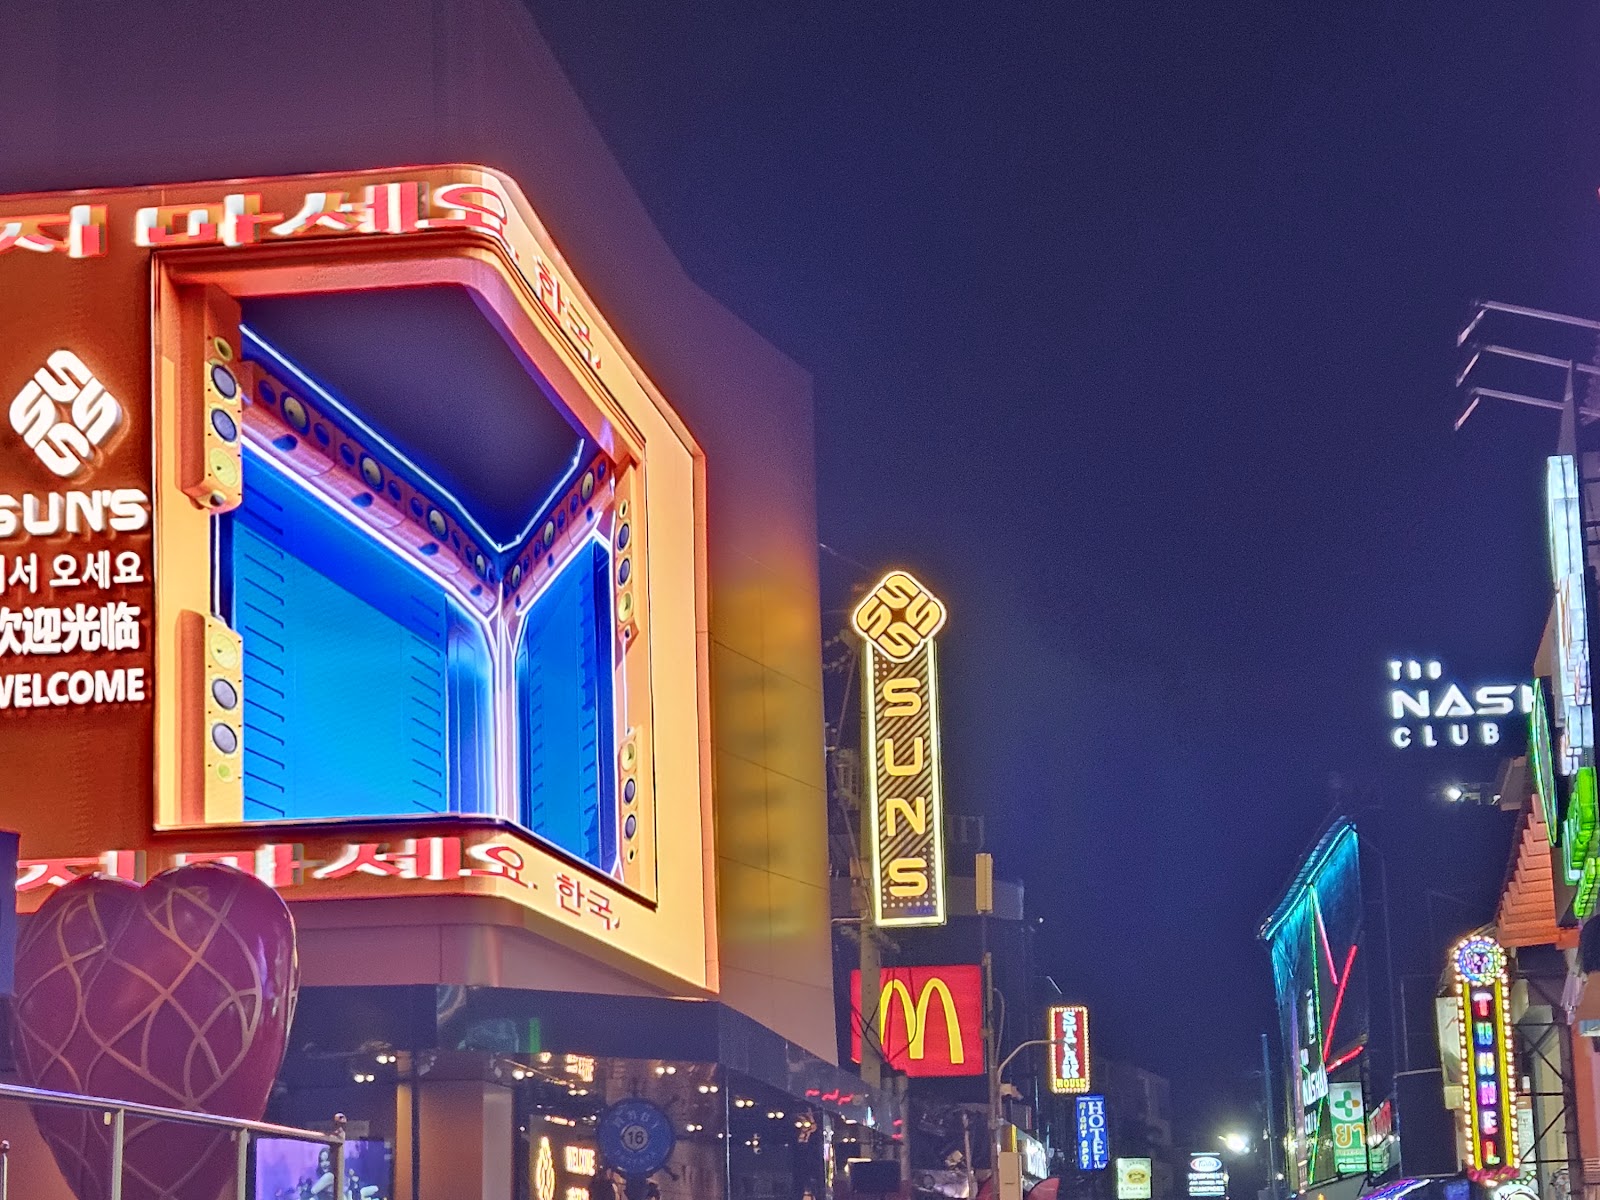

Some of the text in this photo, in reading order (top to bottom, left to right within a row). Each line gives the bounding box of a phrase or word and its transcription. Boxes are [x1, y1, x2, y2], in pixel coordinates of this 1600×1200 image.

[49, 550, 144, 590] 오세요
[1393, 722, 1500, 748] CLUB
[882, 676, 929, 897] SUNS
[1056, 1079, 1086, 1089] HOUSE
[1472, 991, 1501, 1165] TUNNEL
[627, 1130, 645, 1146] 16
